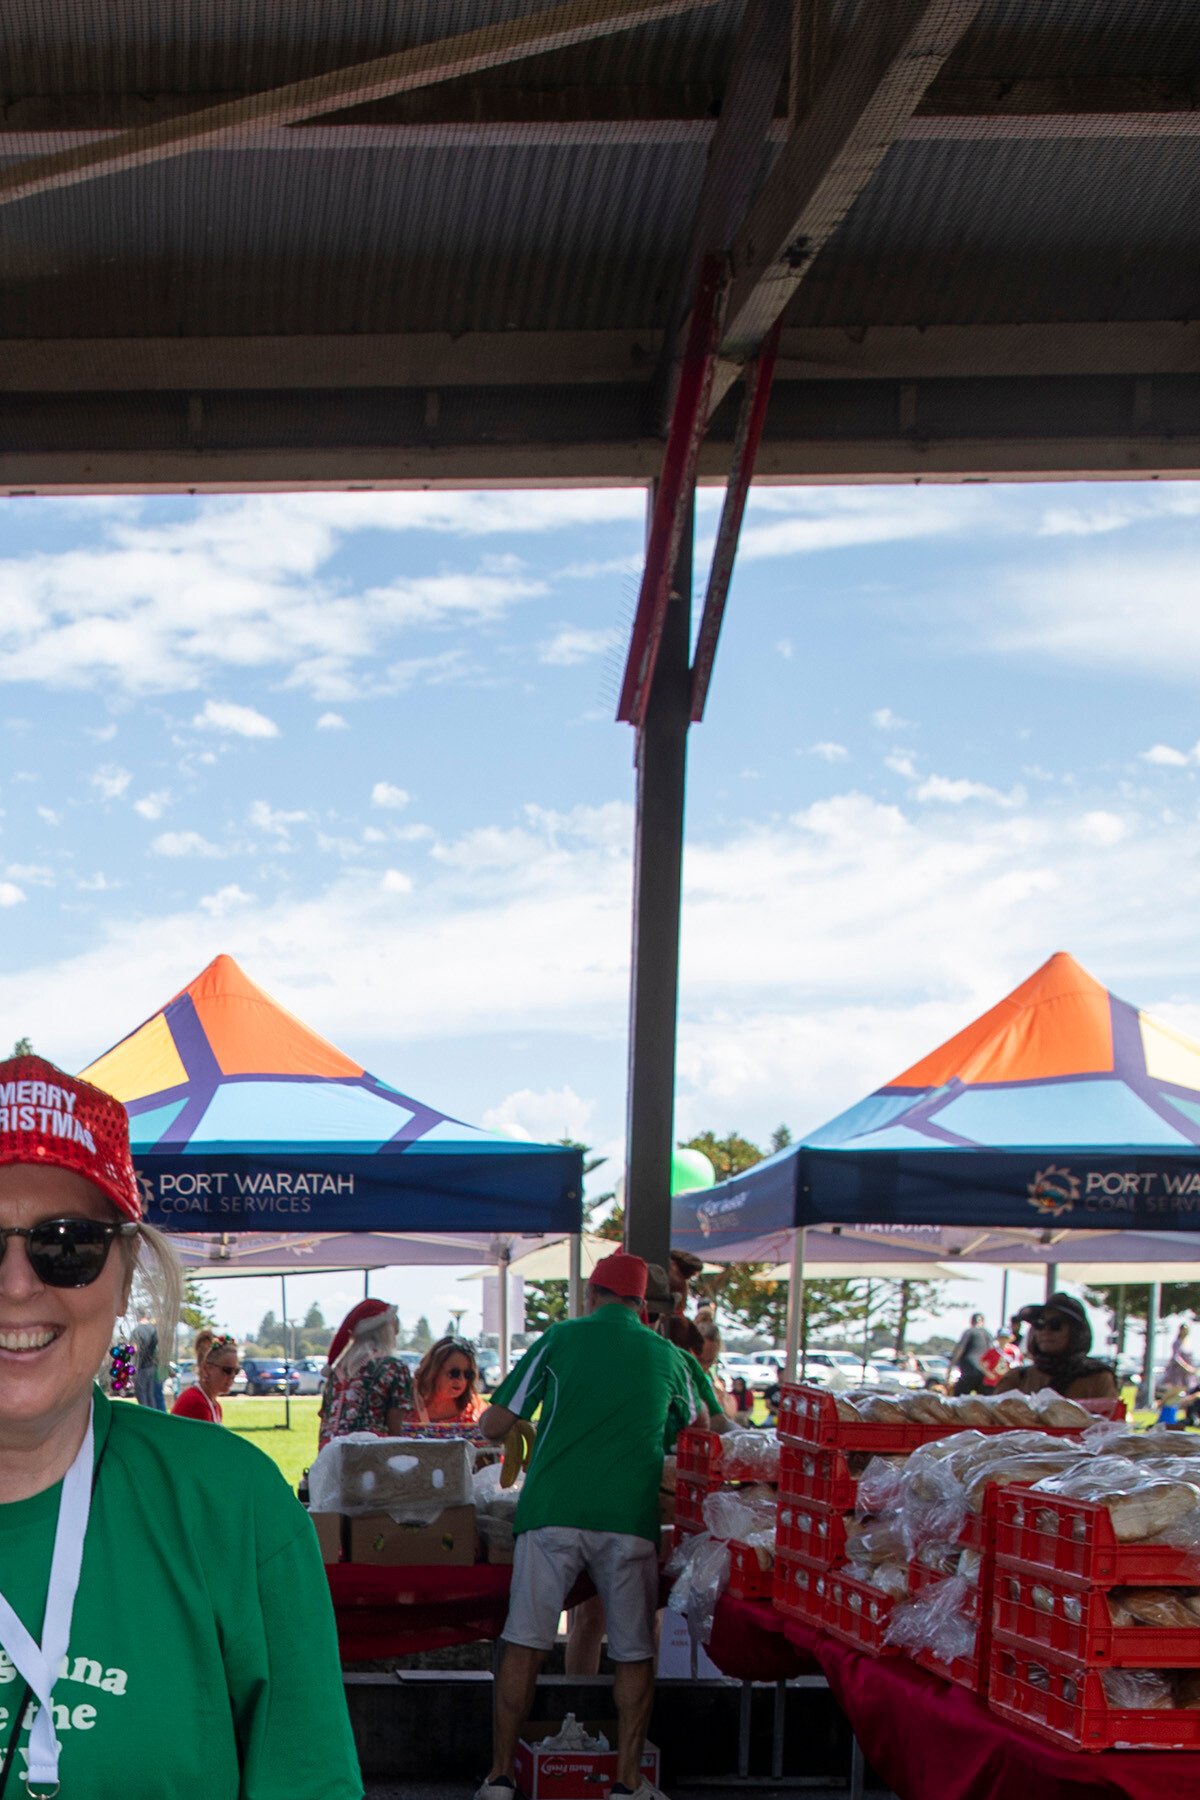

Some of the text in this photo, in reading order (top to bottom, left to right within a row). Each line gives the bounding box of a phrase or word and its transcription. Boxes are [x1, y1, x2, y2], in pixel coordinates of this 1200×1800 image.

[159, 1173, 354, 1195] PORT WARATAH
[1085, 1172, 1158, 1195] PORT
[159, 1196, 311, 1213] COAL SERVICES
